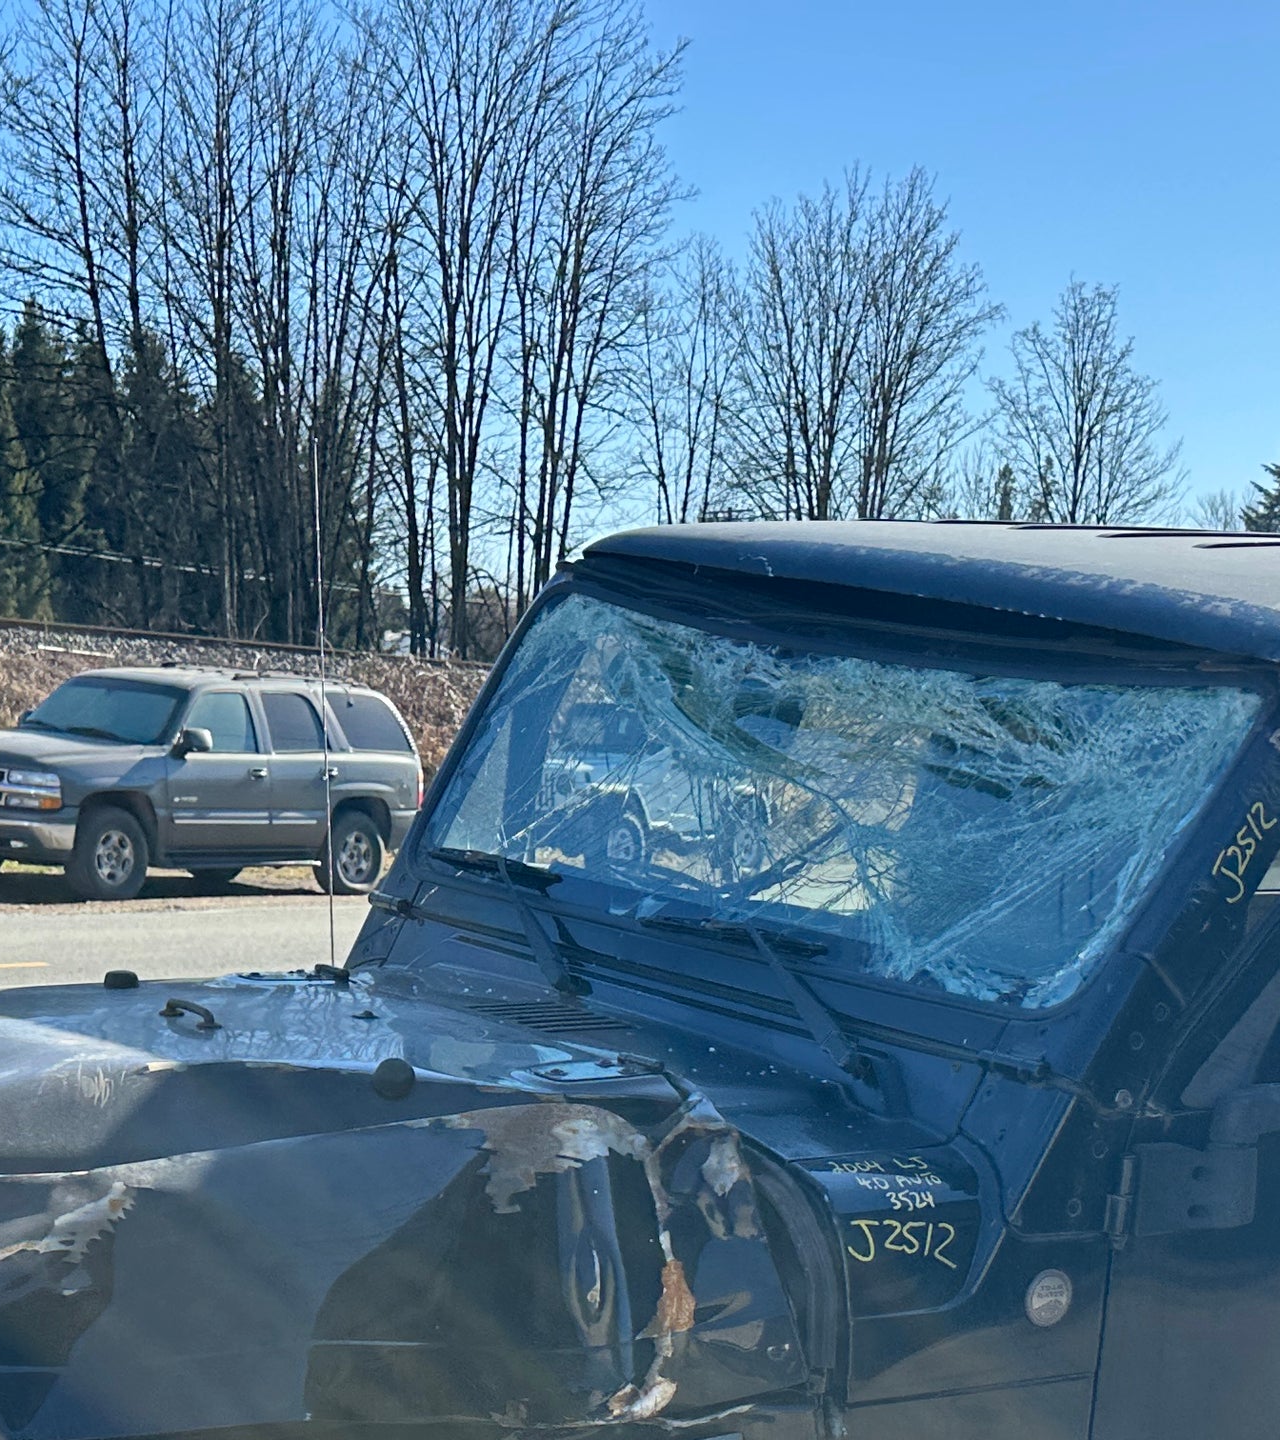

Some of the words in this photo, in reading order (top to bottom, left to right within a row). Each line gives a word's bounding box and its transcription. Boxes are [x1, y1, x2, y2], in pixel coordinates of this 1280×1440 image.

[1212, 801, 1278, 903] J2512
[828, 1160, 885, 1174] 2004
[892, 1155, 928, 1170] LJ
[855, 1175, 890, 1190] 4.0
[886, 1189, 935, 1211] 3524
[847, 1219, 957, 1269] J2512
